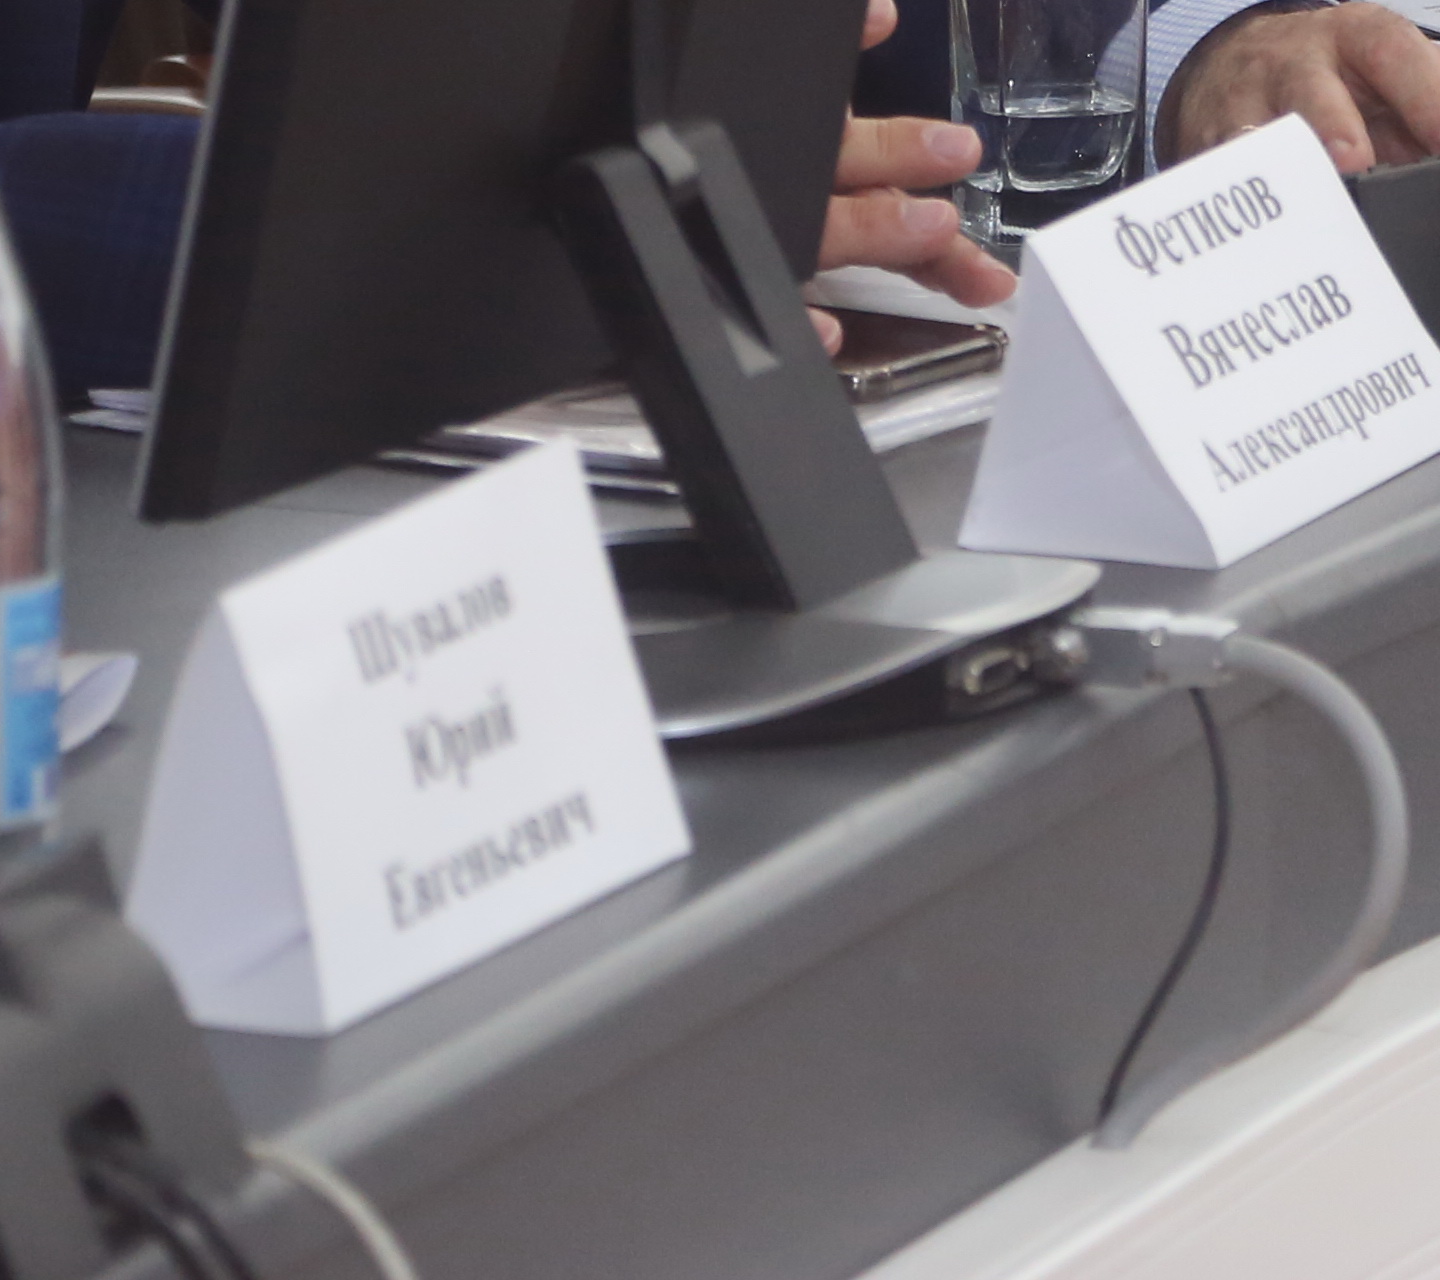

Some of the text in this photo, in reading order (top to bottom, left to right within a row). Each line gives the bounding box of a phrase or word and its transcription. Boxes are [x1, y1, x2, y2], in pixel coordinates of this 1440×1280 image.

[1114, 176, 1283, 278] Фетисов
[1161, 274, 1352, 389] Вячеслав
[1201, 352, 1431, 493] Александрович
[347, 574, 514, 684] Шувалов
[404, 687, 516, 789] Юрий
[382, 792, 595, 932] Евгеньевич
